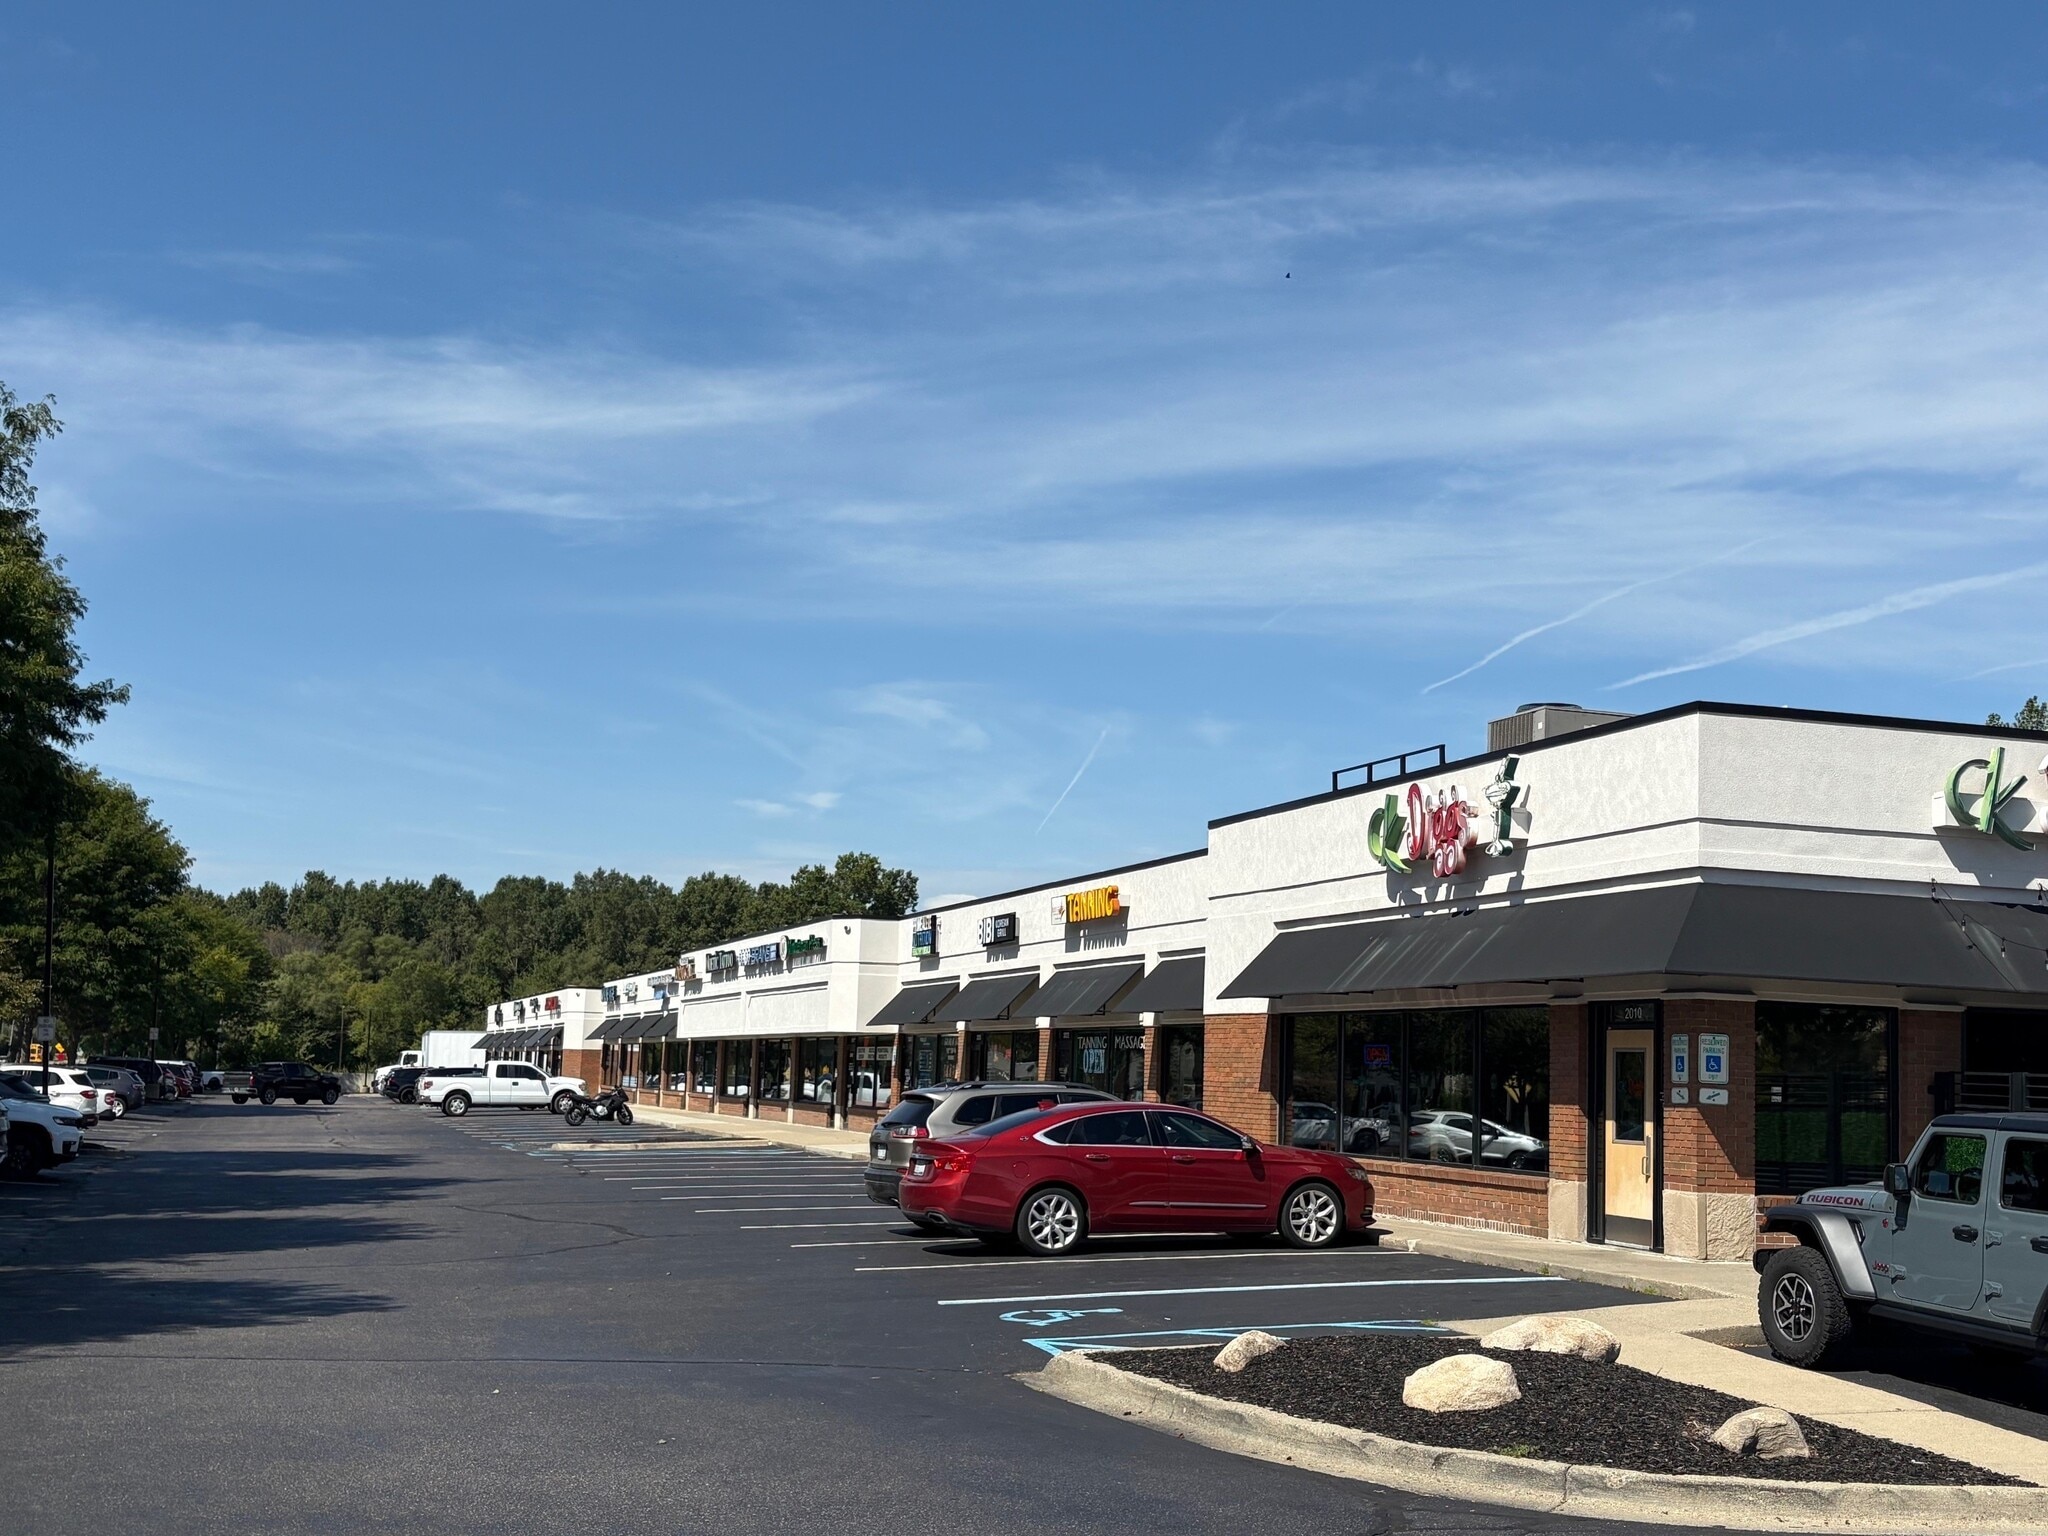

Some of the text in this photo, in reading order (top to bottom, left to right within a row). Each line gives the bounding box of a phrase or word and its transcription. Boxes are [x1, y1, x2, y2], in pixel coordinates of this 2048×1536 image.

[1067, 885, 1118, 923] TANNING
[1624, 1007, 1642, 1019] 2010
[1078, 1036, 1107, 1050] TANNING
[1701, 1038, 1728, 1047] RESERVED
[1703, 1047, 1725, 1055] PARKING
[1083, 1049, 1105, 1074] OPEN
[1806, 1195, 1865, 1207] RUBICON
